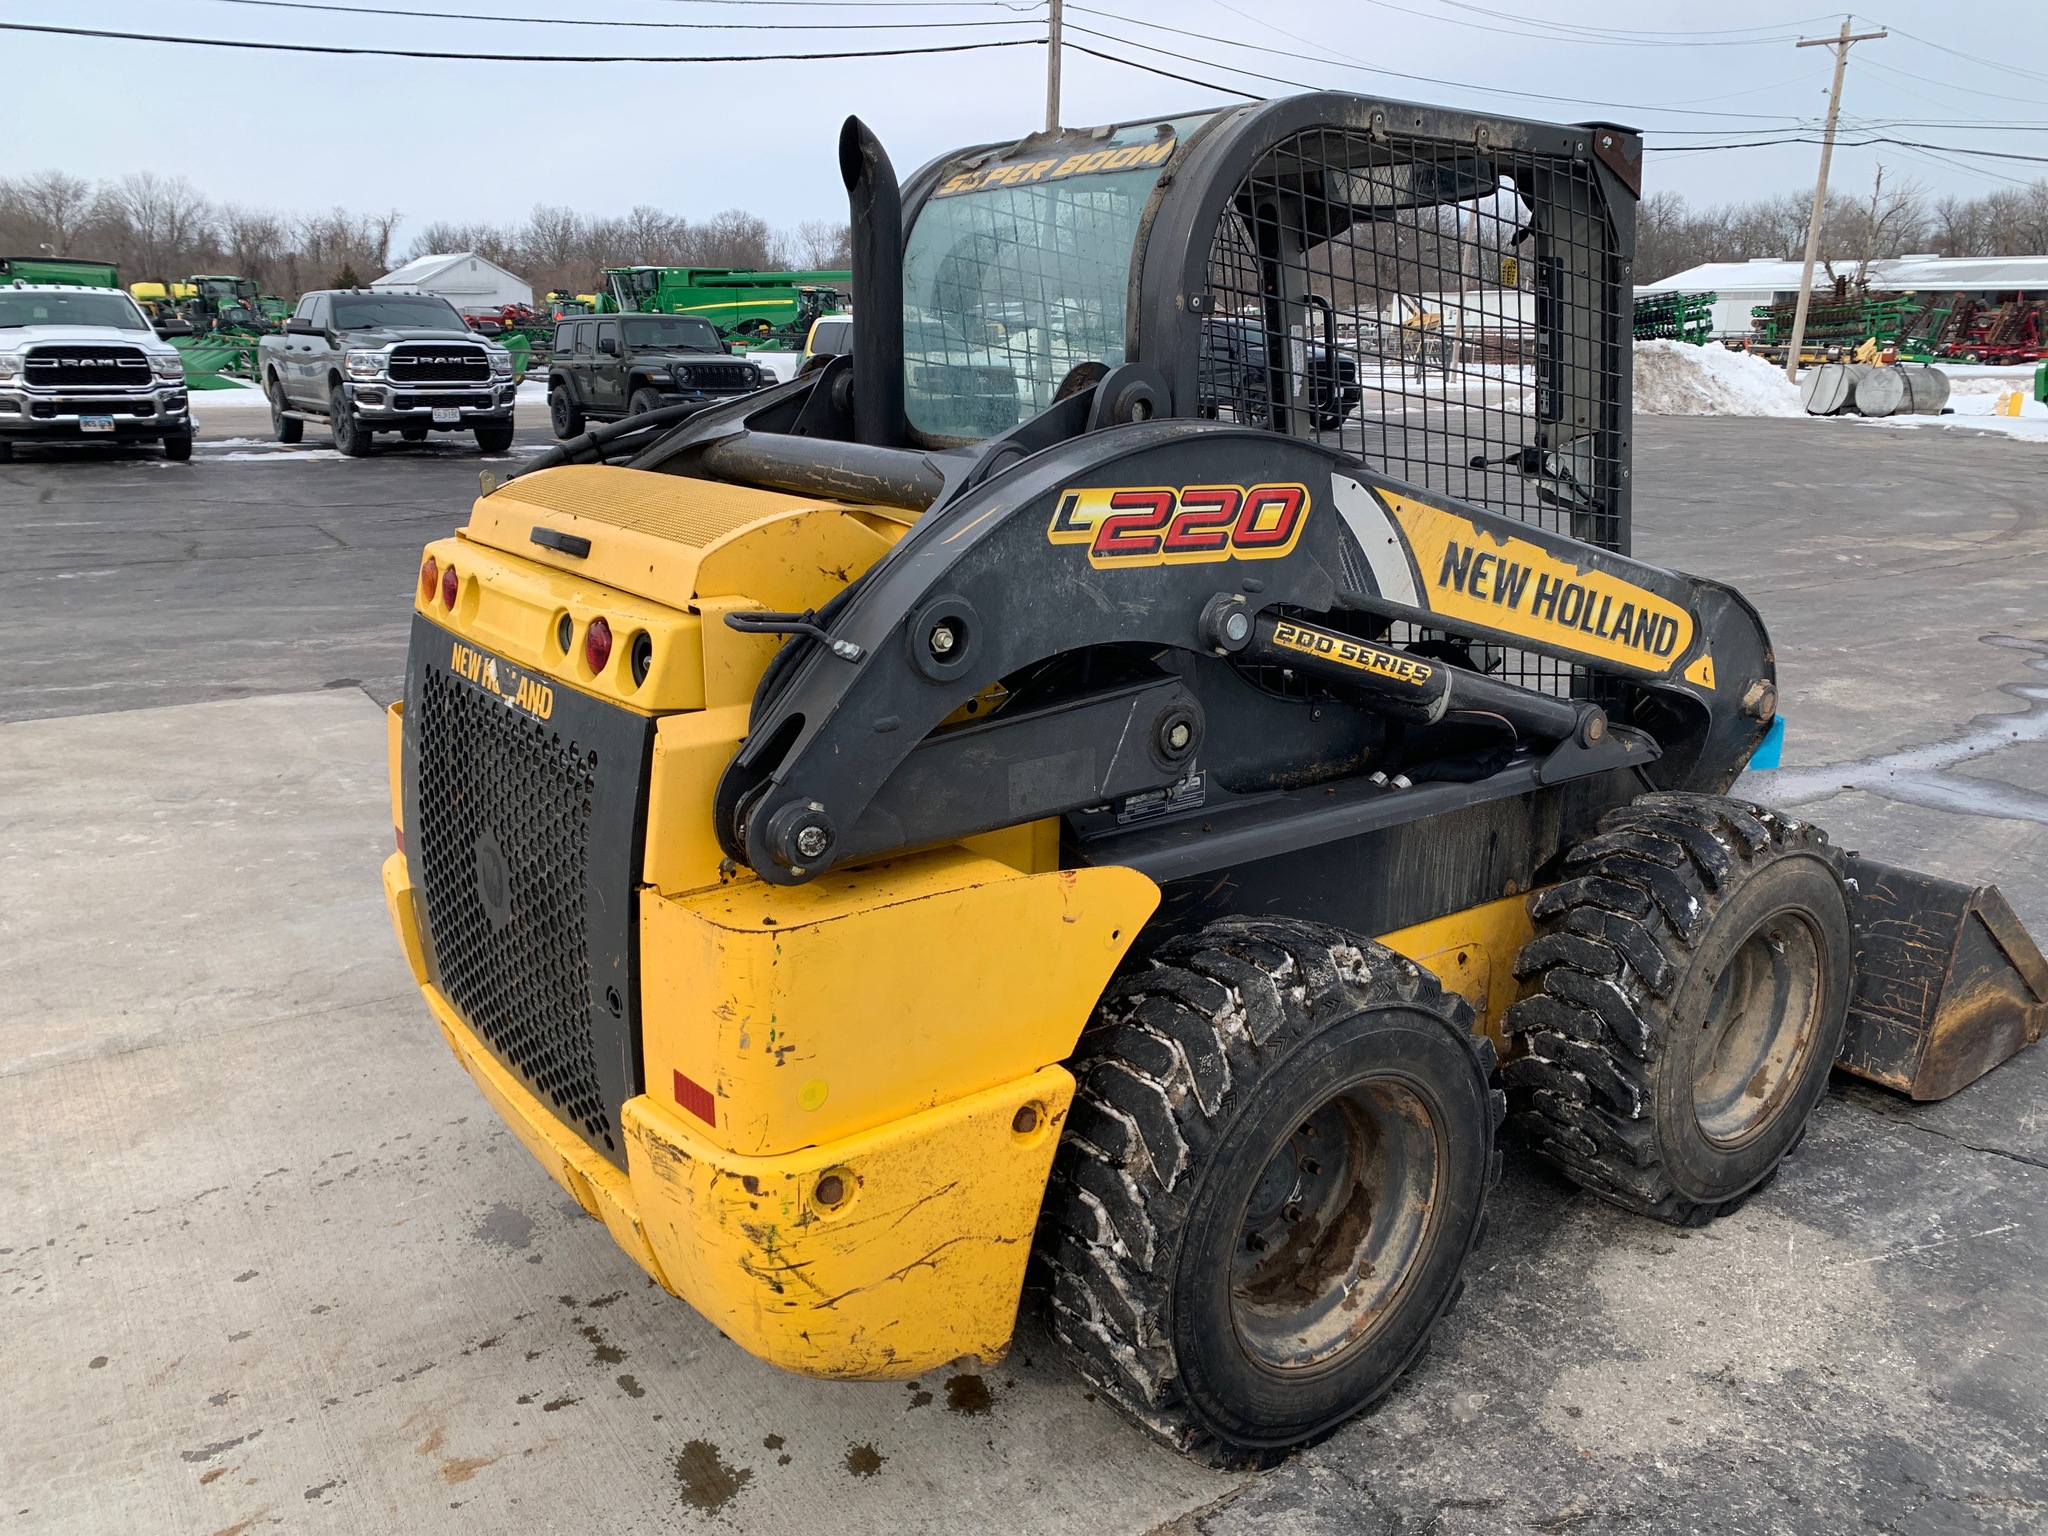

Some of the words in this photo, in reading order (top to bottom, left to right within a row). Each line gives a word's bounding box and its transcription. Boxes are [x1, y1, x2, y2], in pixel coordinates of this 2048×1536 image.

[1052, 138, 1175, 177] BOOM
[60, 358, 115, 367] RAM
[1051, 487, 1306, 558] L220
[1437, 540, 1532, 612] NEW
[1530, 572, 1680, 659] HOLLAND
[451, 642, 482, 683] NEW
[1276, 623, 1334, 654] 200
[1338, 643, 1430, 681] SERIES
